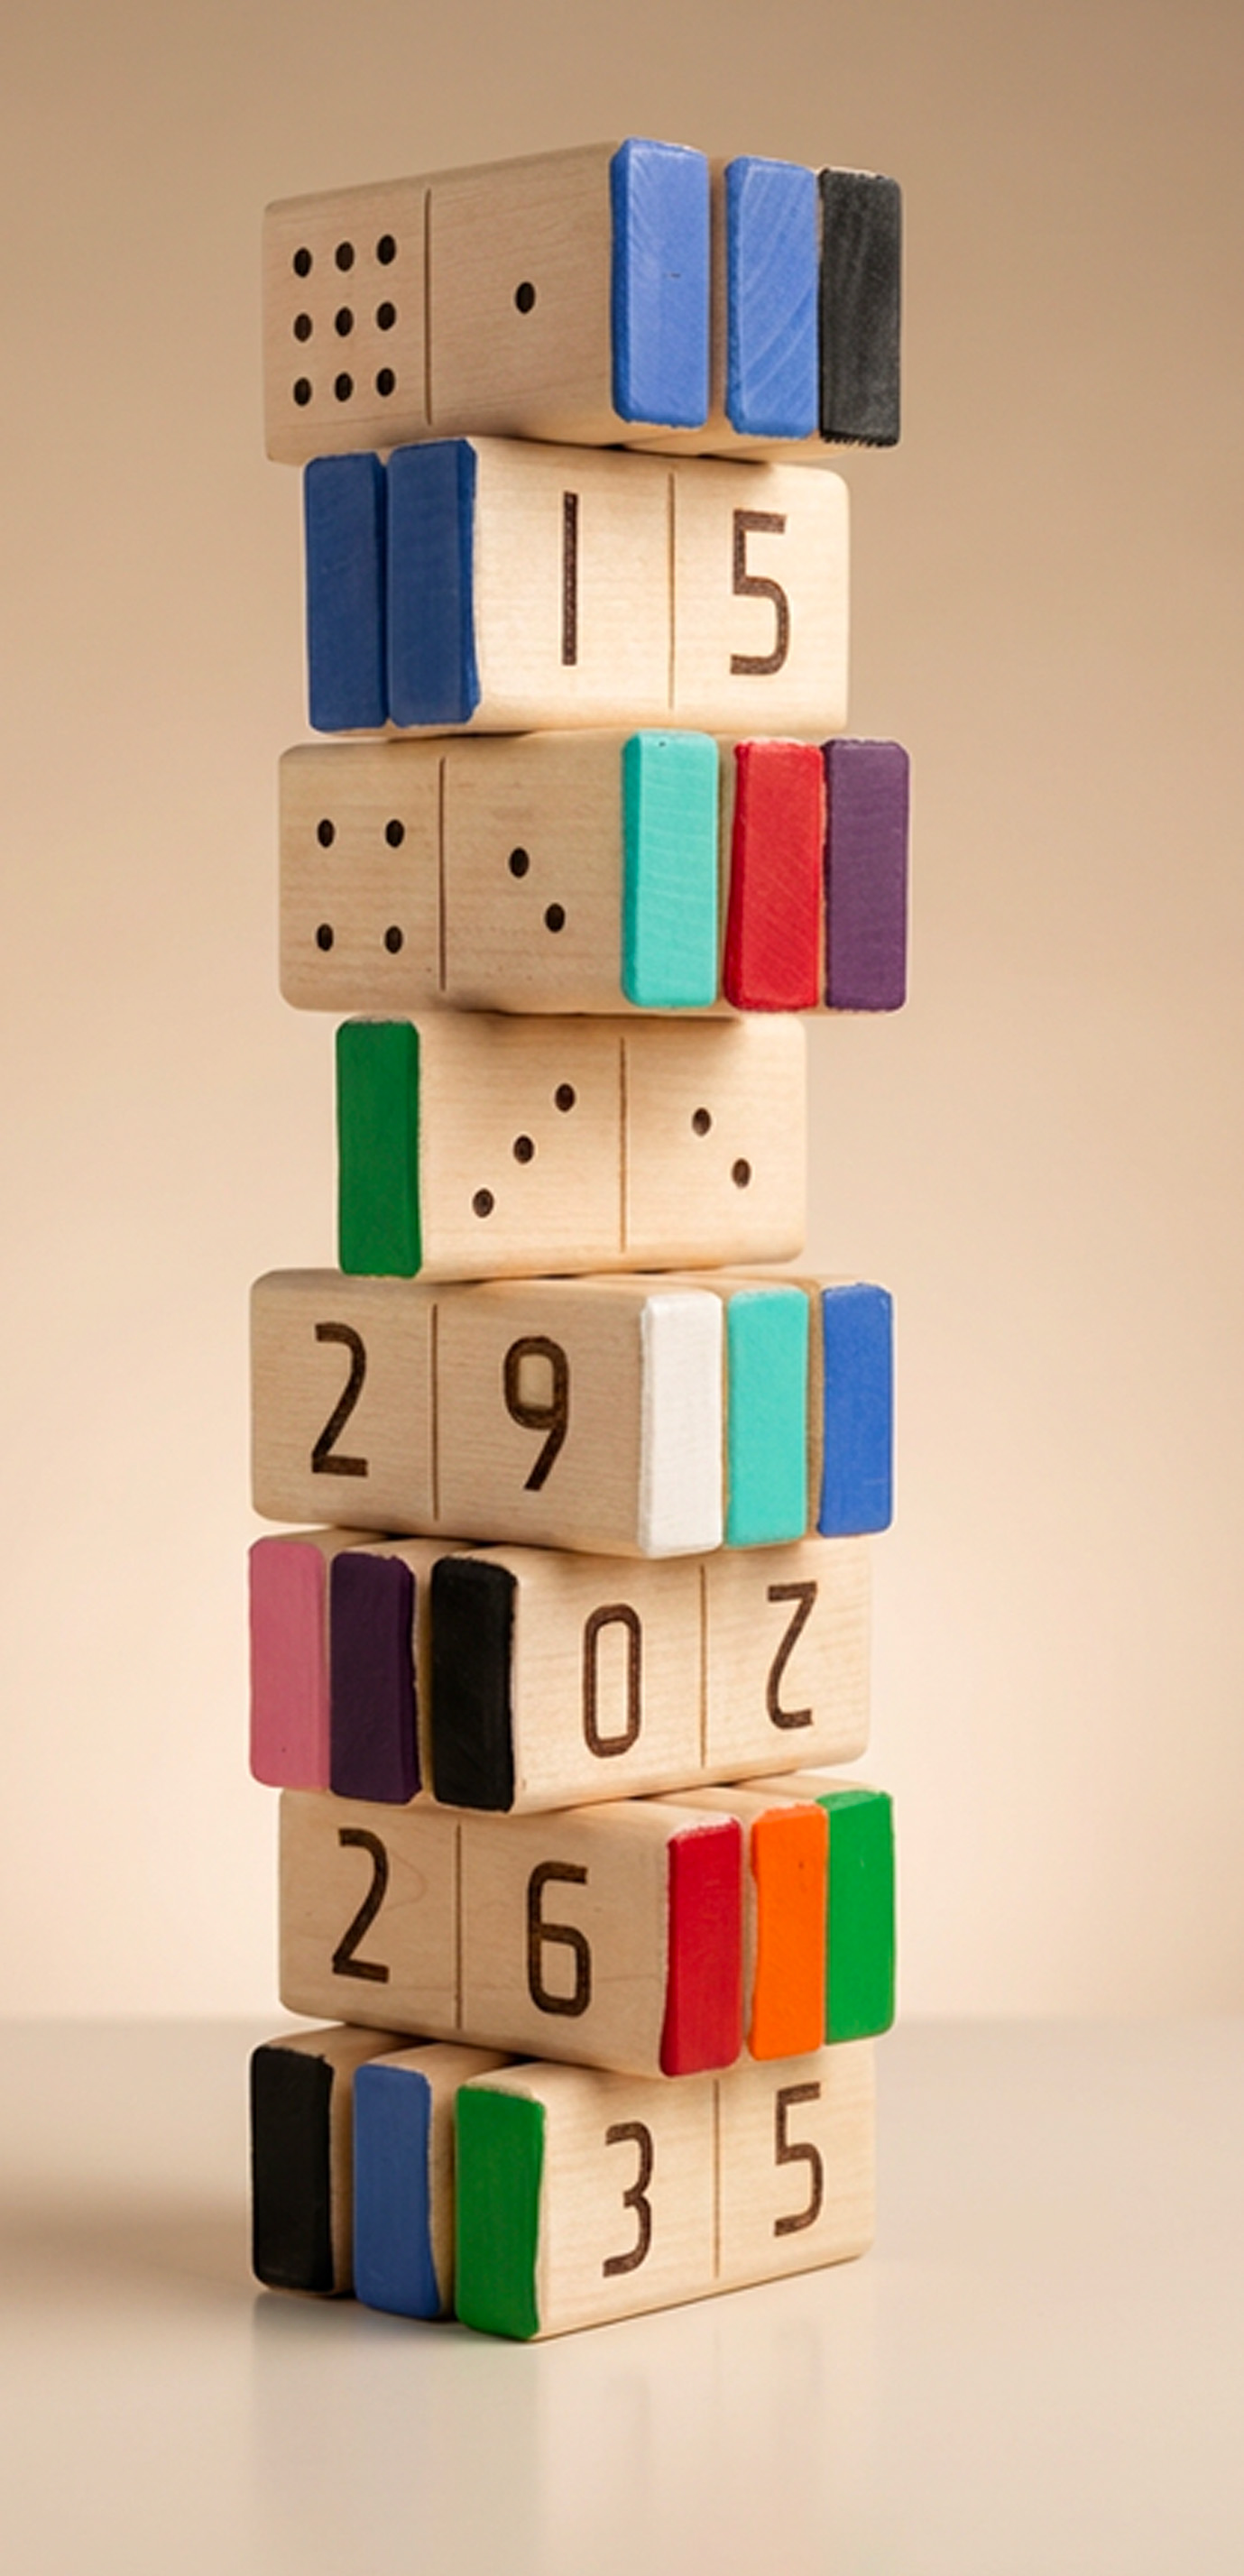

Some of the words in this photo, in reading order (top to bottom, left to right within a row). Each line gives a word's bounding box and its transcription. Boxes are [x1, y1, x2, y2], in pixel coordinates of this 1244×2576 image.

[562, 491, 578, 666] 1
[730, 509, 789, 676] 5
[311, 1321, 368, 1478] 2
[502, 1335, 569, 1492] 9
[583, 1603, 642, 1758] 0
[766, 1580, 817, 1730] 2
[331, 1827, 390, 1984] 2
[526, 1861, 592, 2019] 6
[603, 2121, 653, 2277] 3
[773, 2082, 824, 2237] 5
